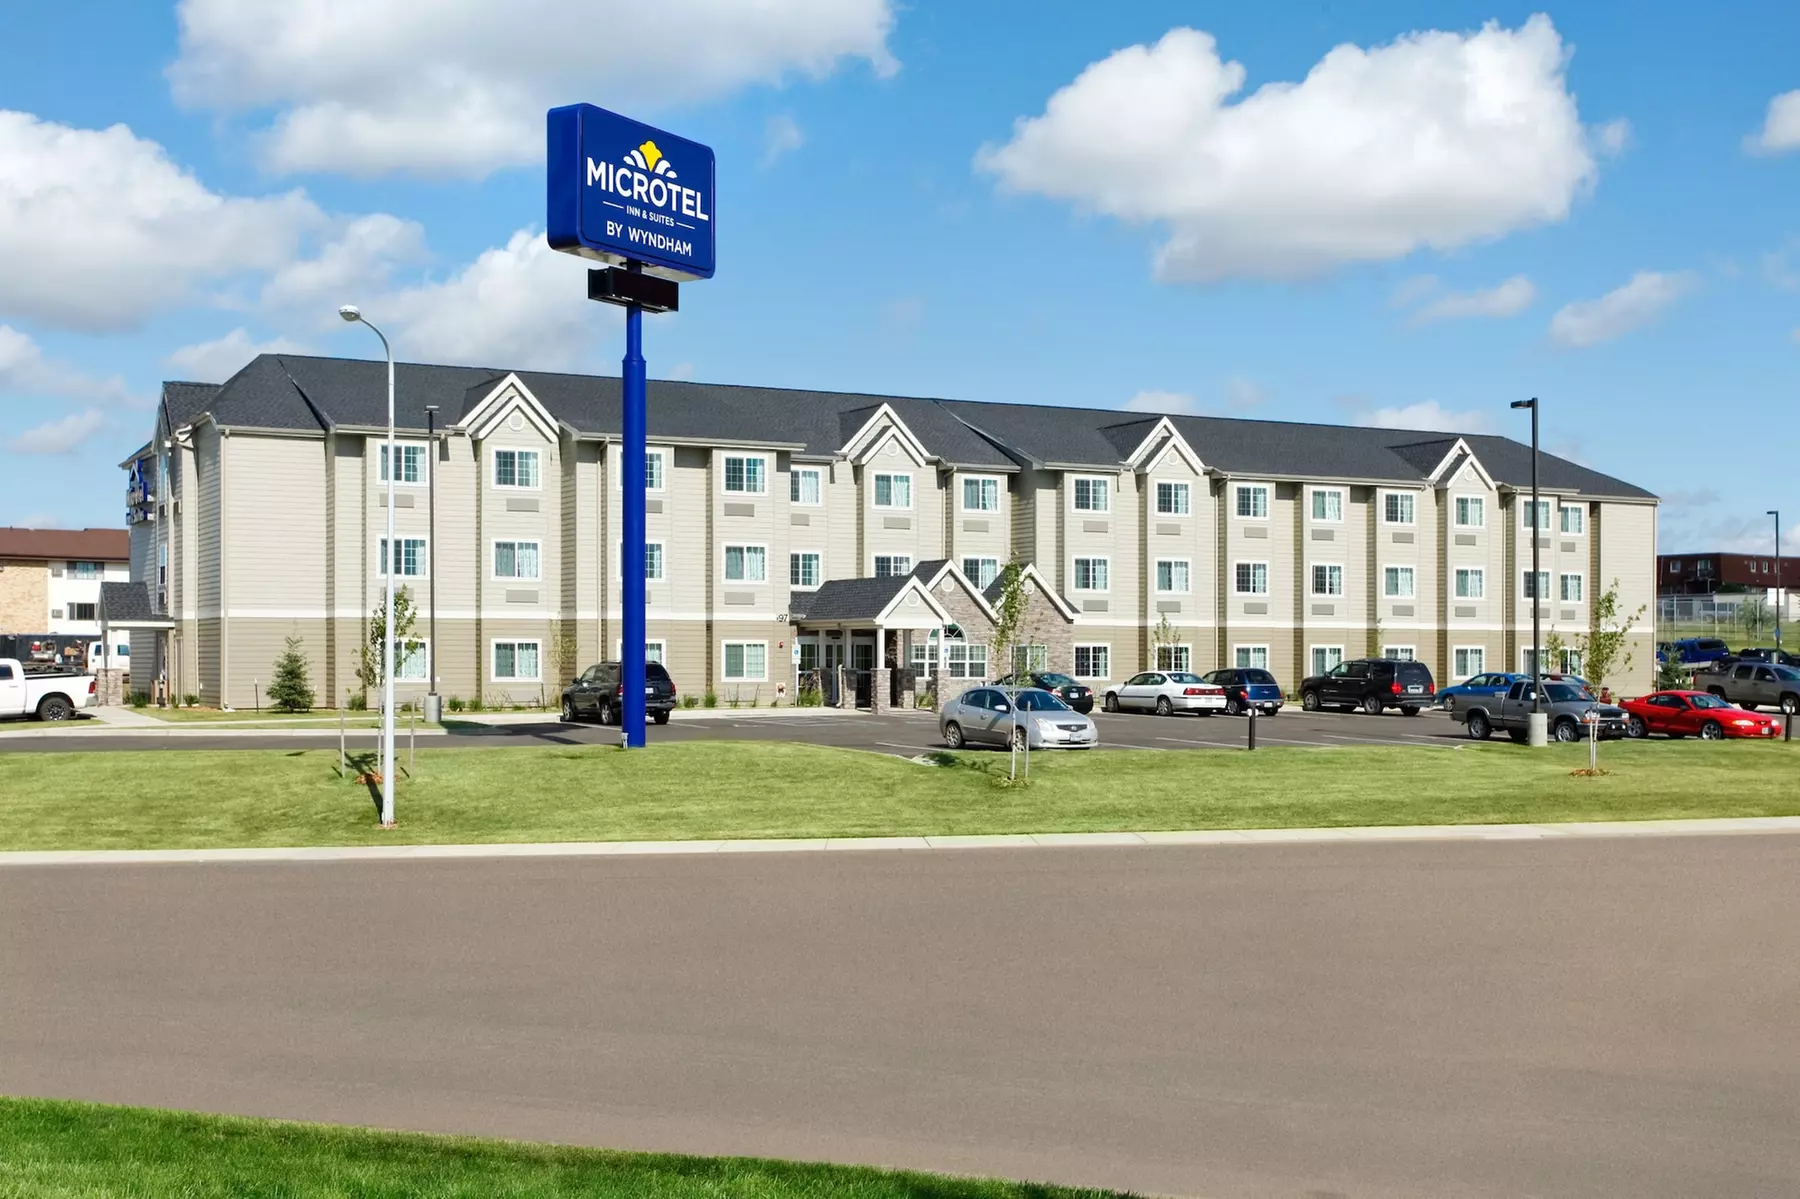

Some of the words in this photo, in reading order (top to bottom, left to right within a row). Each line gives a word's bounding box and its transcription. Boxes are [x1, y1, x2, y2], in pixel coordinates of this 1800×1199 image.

[587, 157, 709, 221] MICROTEL
[627, 205, 640, 217] INN
[642, 210, 648, 219] &
[649, 212, 675, 227] SUITES
[607, 220, 623, 238] BY
[628, 226, 692, 257] WYNDHAM
